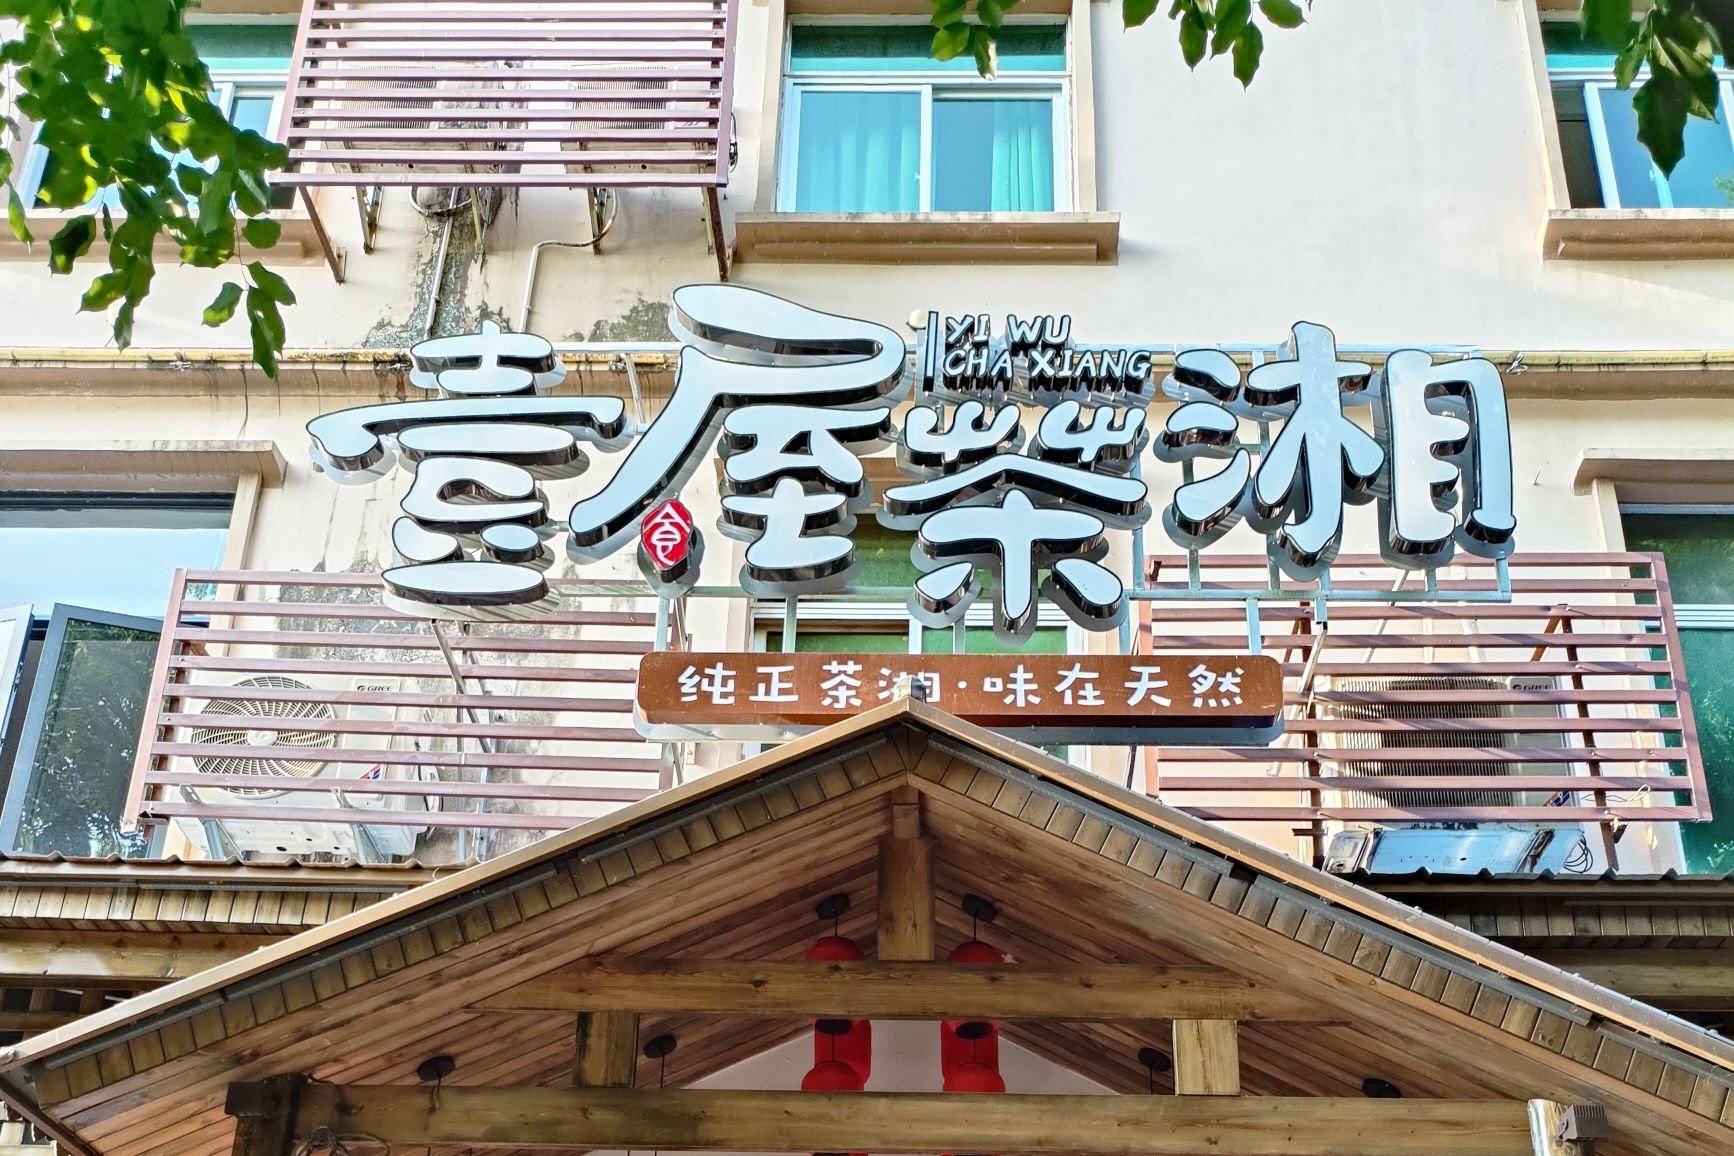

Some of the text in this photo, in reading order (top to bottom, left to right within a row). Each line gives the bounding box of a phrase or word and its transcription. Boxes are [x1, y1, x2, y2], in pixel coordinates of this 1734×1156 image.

[945, 314, 1072, 345] YI WU
[942, 348, 1152, 380] CHA XIANG
[306, 283, 1517, 622] 壹屋茶湘
[366, 684, 393, 693] GREE
